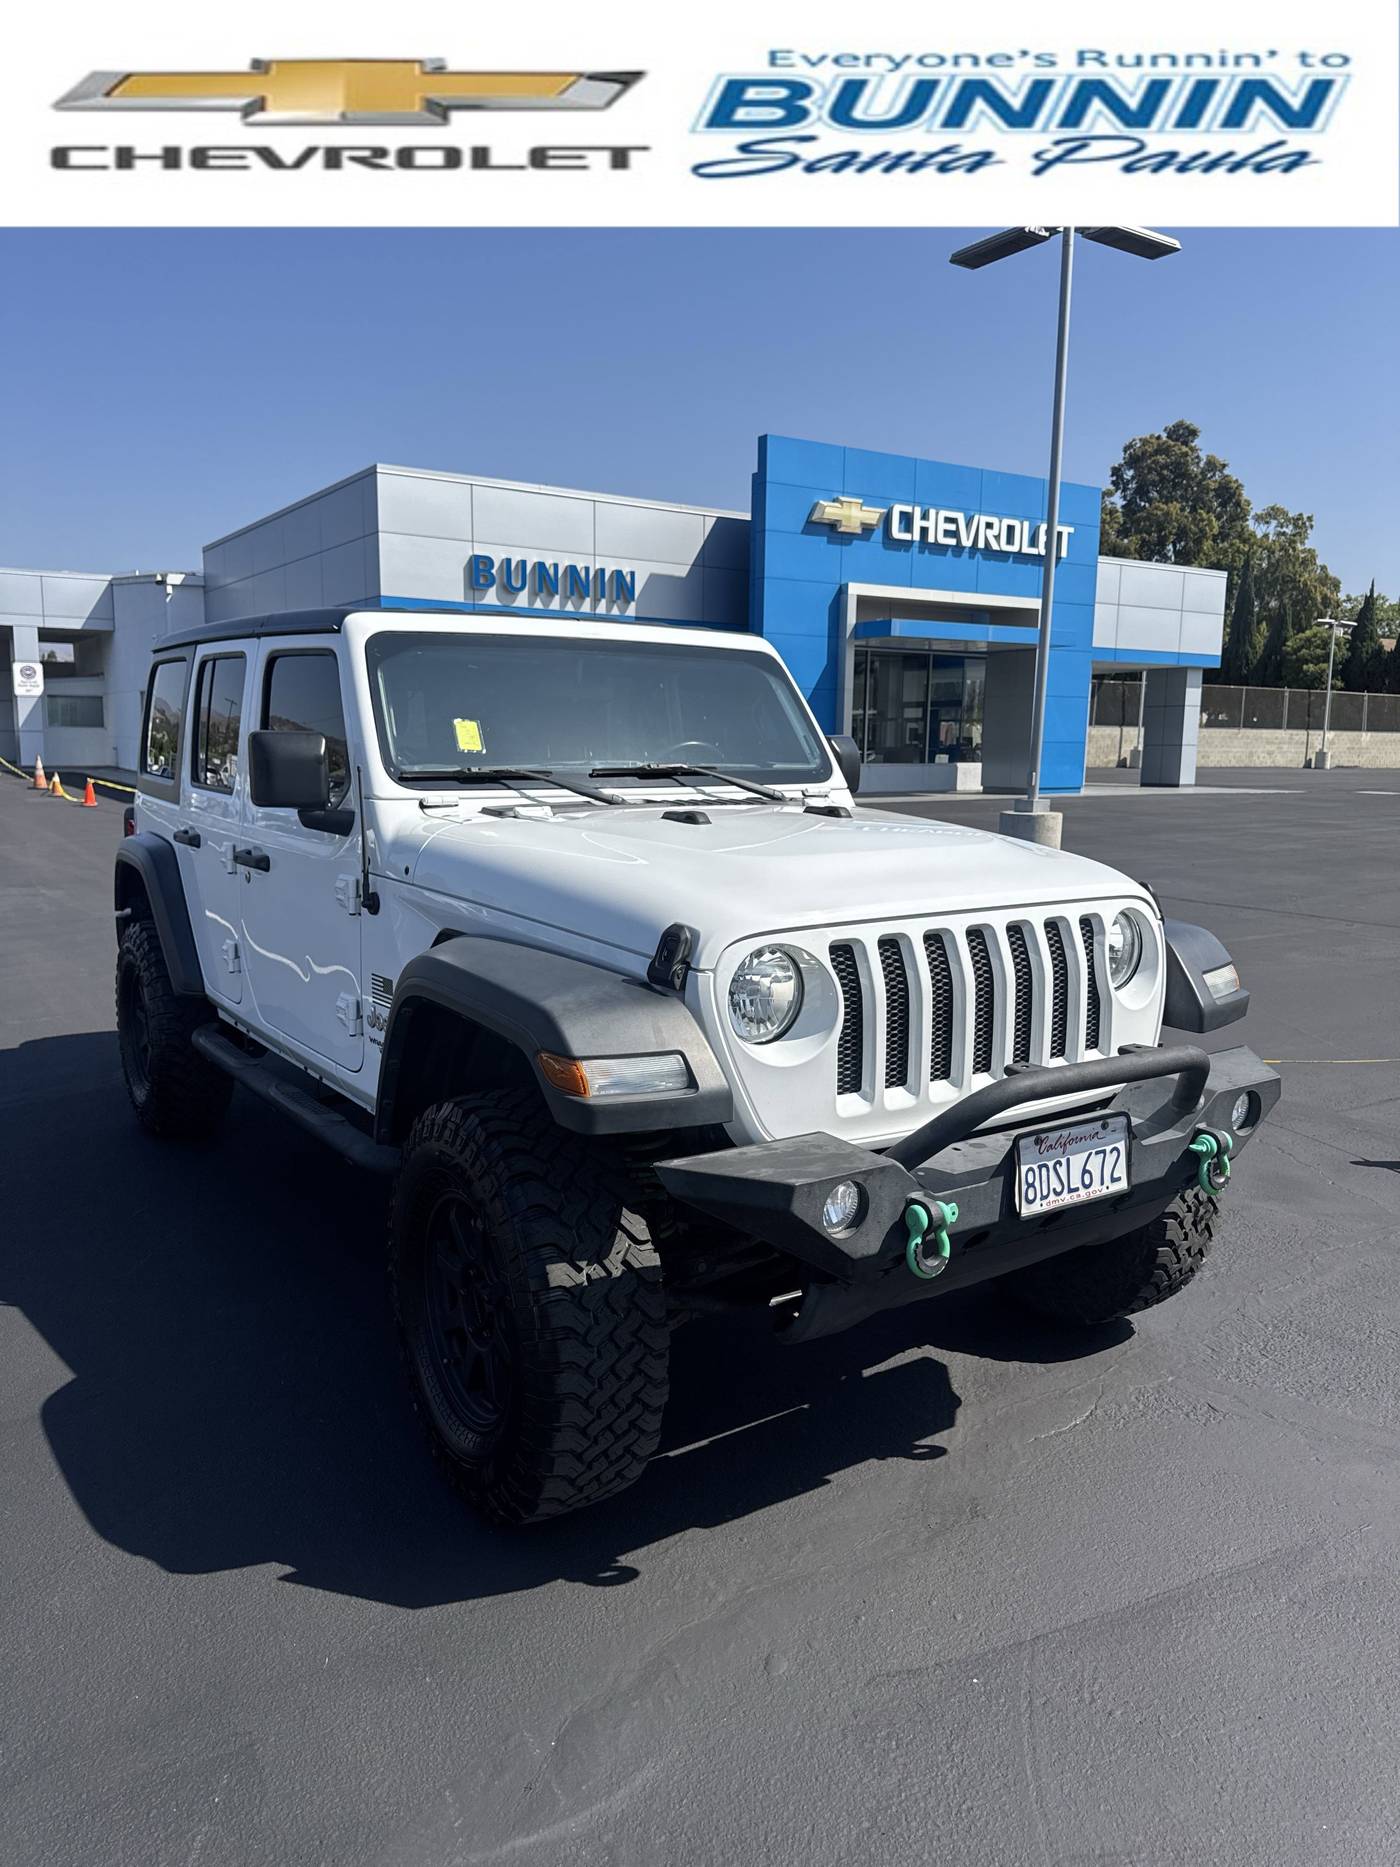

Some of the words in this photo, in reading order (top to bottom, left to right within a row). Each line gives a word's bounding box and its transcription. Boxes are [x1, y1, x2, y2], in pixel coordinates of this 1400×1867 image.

[471, 554, 636, 602] BUNNIN
[1038, 1129, 1106, 1155] California
[1024, 1146, 1122, 1205] 8DSL672
[1045, 1187, 1104, 1208] dmv.ca.gov
